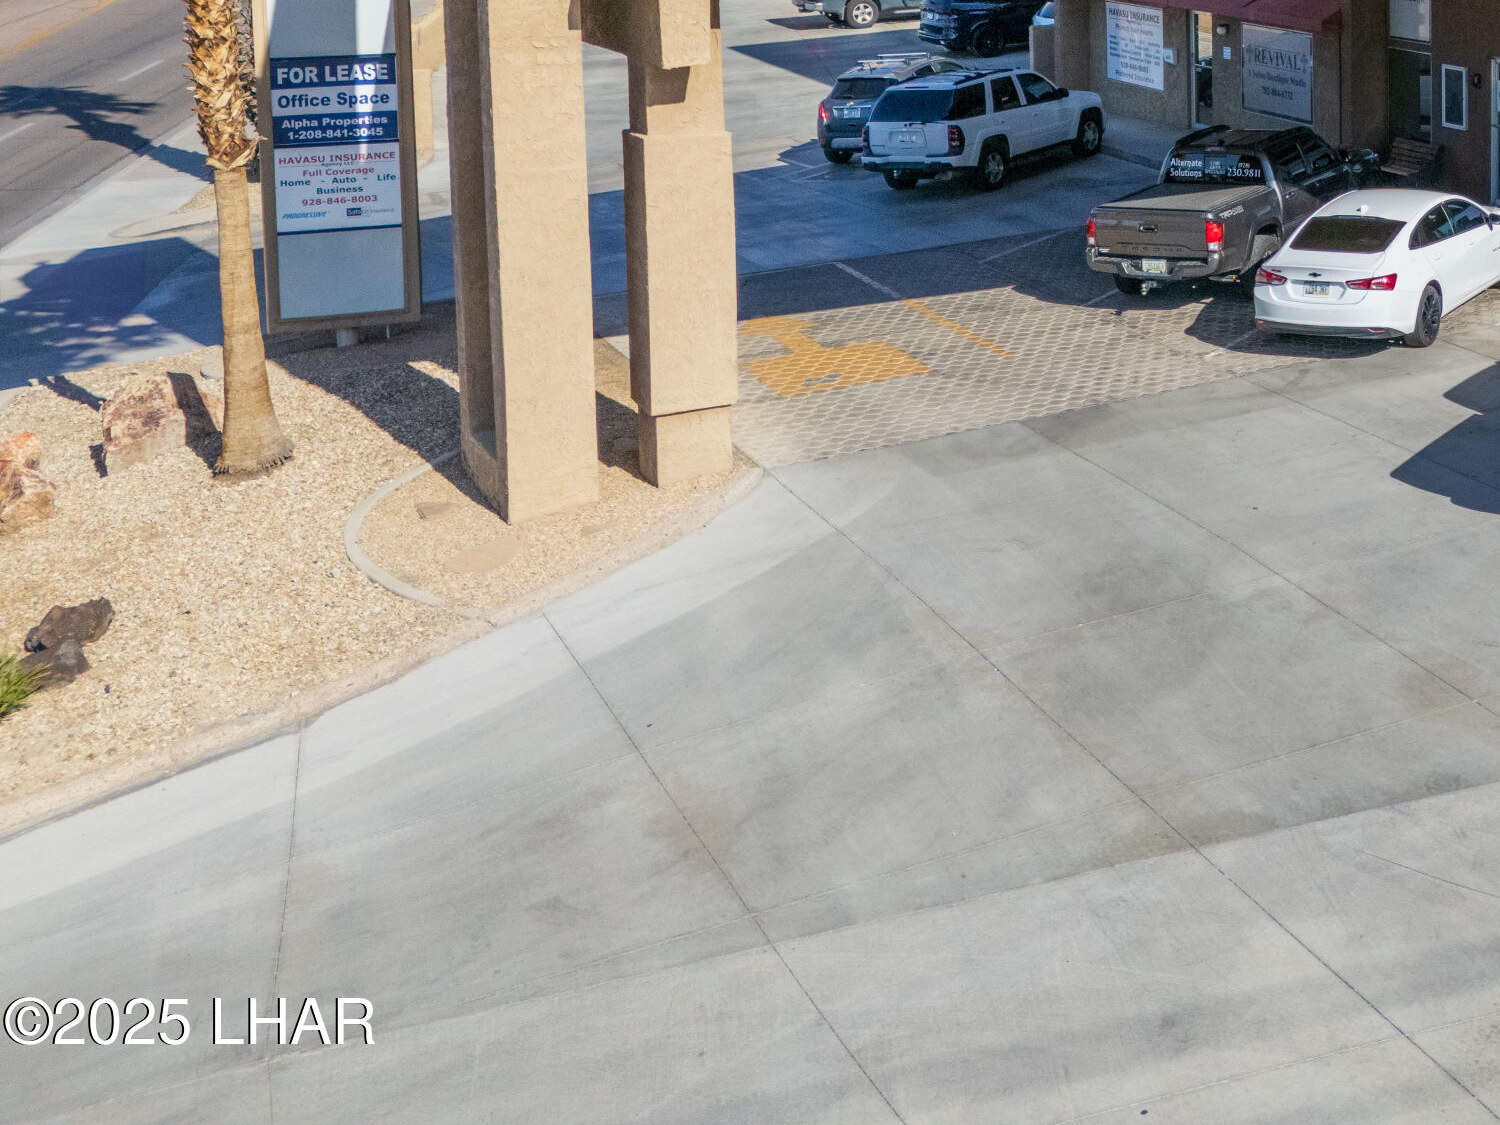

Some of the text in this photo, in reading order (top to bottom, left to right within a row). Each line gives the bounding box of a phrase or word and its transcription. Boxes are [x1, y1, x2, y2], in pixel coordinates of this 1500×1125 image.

[1108, 7, 1129, 19] HAVASU
[1129, 10, 1160, 24] INSURANCE
[1254, 48, 1301, 71] REVIVAL
[277, 63, 389, 85] FOR LEASE
[277, 92, 390, 109] Office Space
[281, 115, 388, 129] Alpha Properties
[287, 127, 383, 140] 1-208-841-3045
[278, 151, 396, 165] HAVASU INSURANCE
[1170, 157, 1203, 168] Alternate
[302, 166, 375, 177] Full Coverage
[1169, 168, 1202, 178] Solutions
[1226, 168, 1261, 178] 230.9811
[280, 173, 397, 187] Home Auto Life
[316, 186, 364, 195] Business
[301, 194, 378, 206] 928-846-8003
